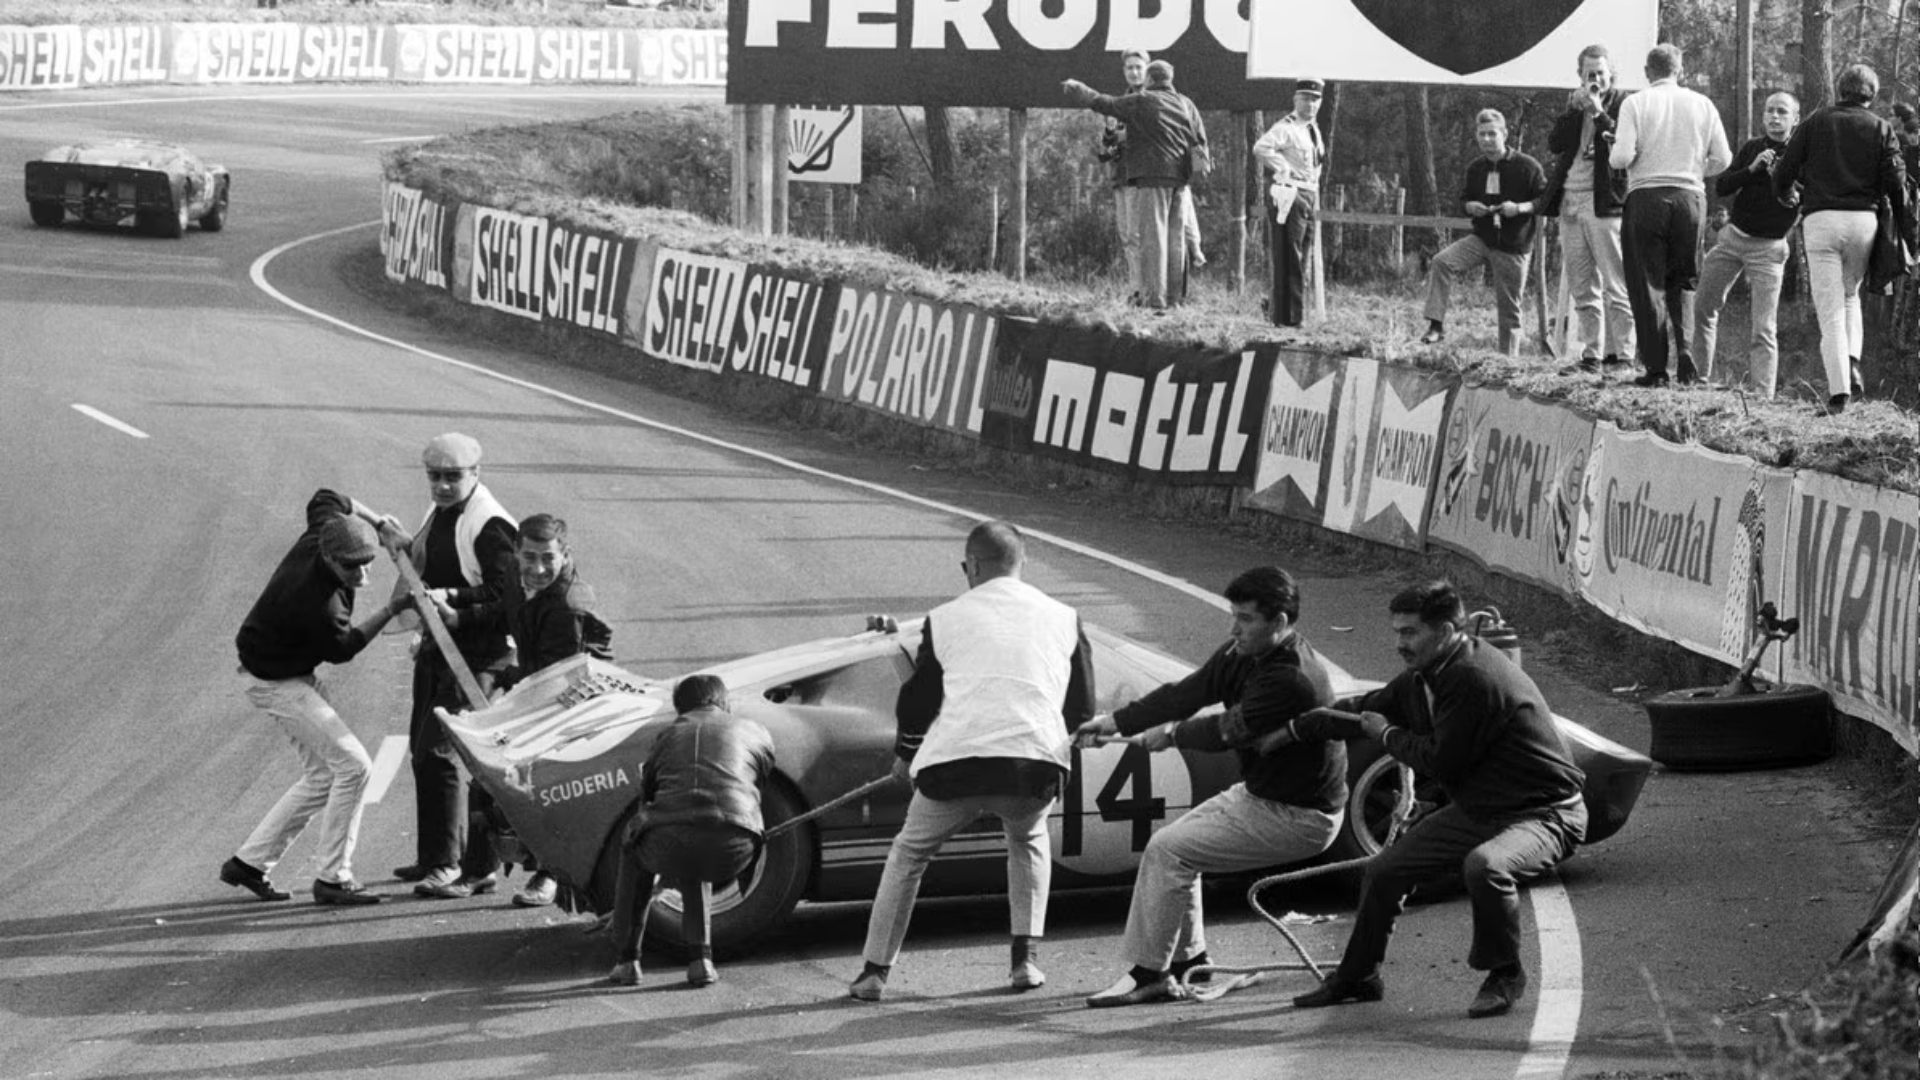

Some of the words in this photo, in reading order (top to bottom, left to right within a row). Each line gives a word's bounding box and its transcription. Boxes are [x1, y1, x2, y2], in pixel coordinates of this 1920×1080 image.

[84, 27, 167, 83] SHELL
[208, 28, 290, 78] SHELL
[301, 25, 389, 78] SHELL
[434, 30, 527, 78] SHELL
[538, 29, 631, 79] SHELL
[476, 214, 541, 314] SHELL
[547, 226, 623, 335] SHELL
[650, 258, 735, 366] SHELL
[732, 273, 823, 387] SHELL
[821, 286, 995, 433] POLAROIL
[1267, 404, 1327, 463] CHAMPION
[1376, 426, 1434, 488] CHAMPION
[1475, 427, 1550, 540] BOSCH
[1604, 476, 1721, 586] Continental
[1793, 495, 1920, 725] MARTEL
[540, 768, 630, 806] SCUDERIA
[1062, 742, 1166, 856] 14
